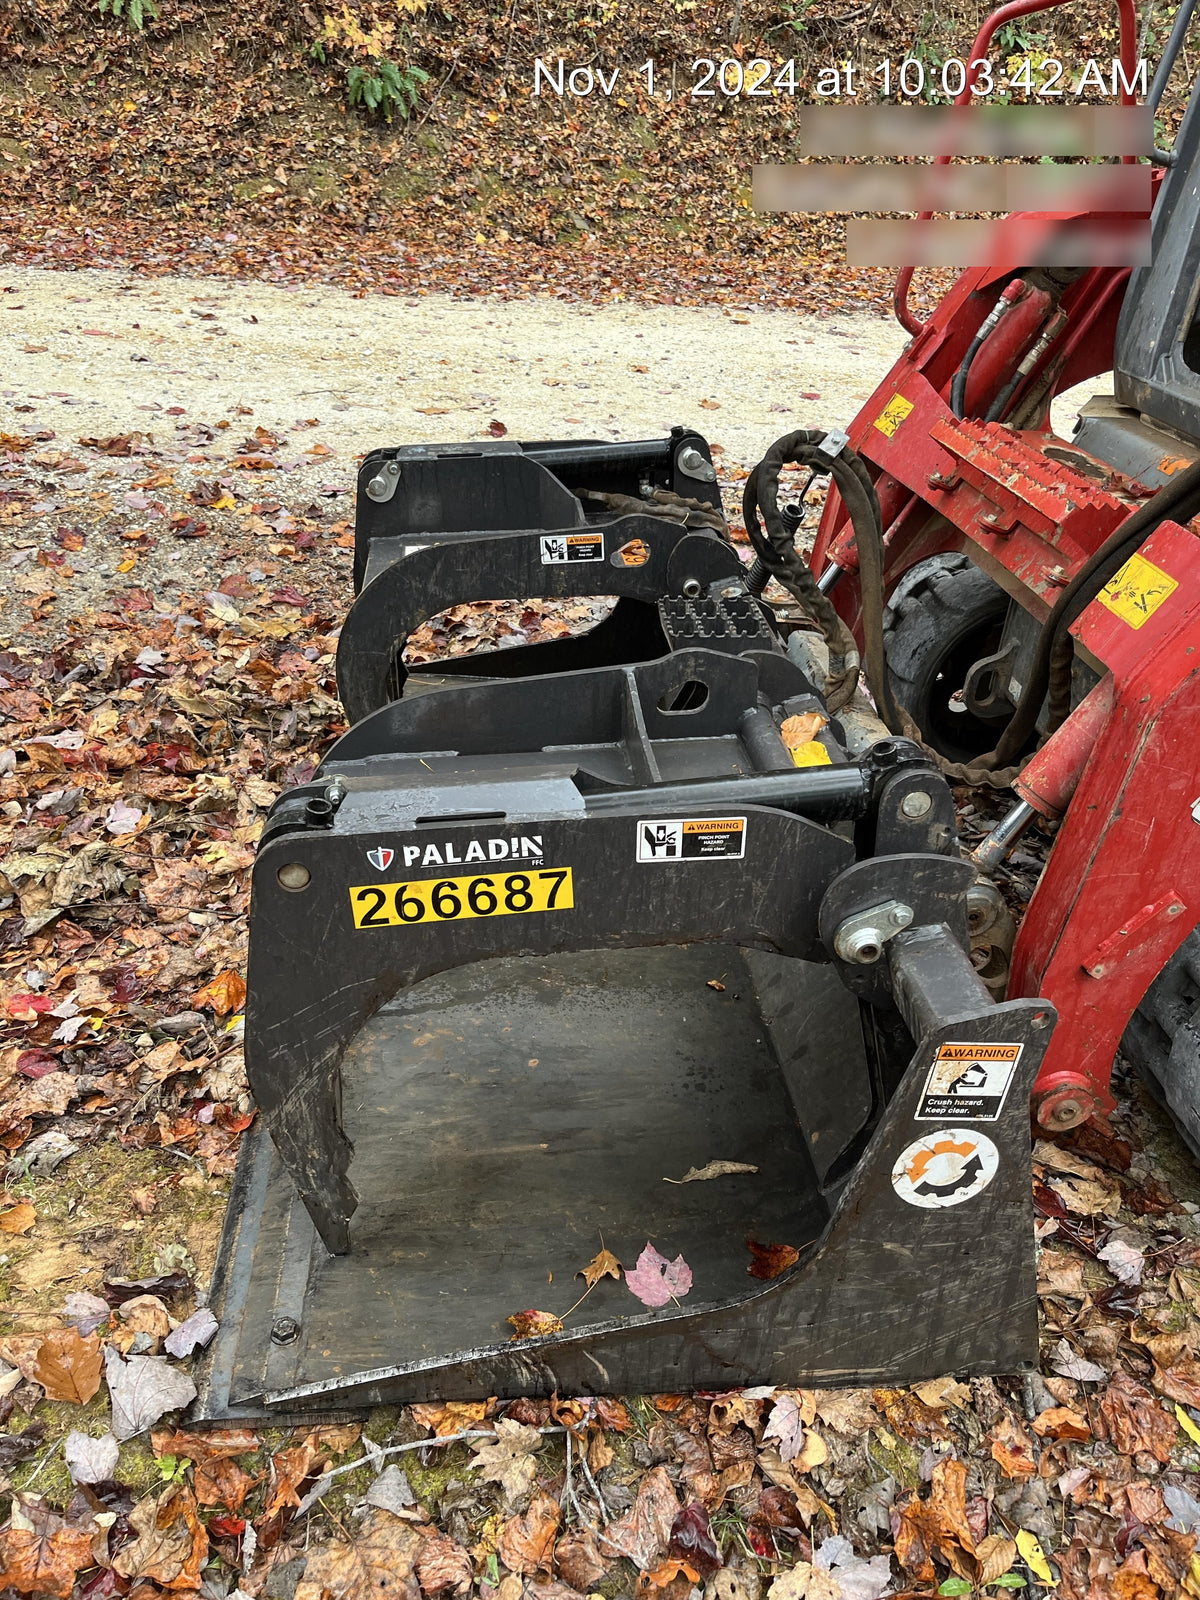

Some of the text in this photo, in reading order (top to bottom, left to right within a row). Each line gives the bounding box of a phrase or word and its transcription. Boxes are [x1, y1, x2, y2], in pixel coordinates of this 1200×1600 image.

[696, 823, 739, 831] WARNING
[402, 835, 544, 867] PALADIN
[531, 858, 545, 866] FFC
[356, 870, 568, 927] 266687
[954, 1049, 1015, 1058] WARNING
[927, 1098, 952, 1106] Crush
